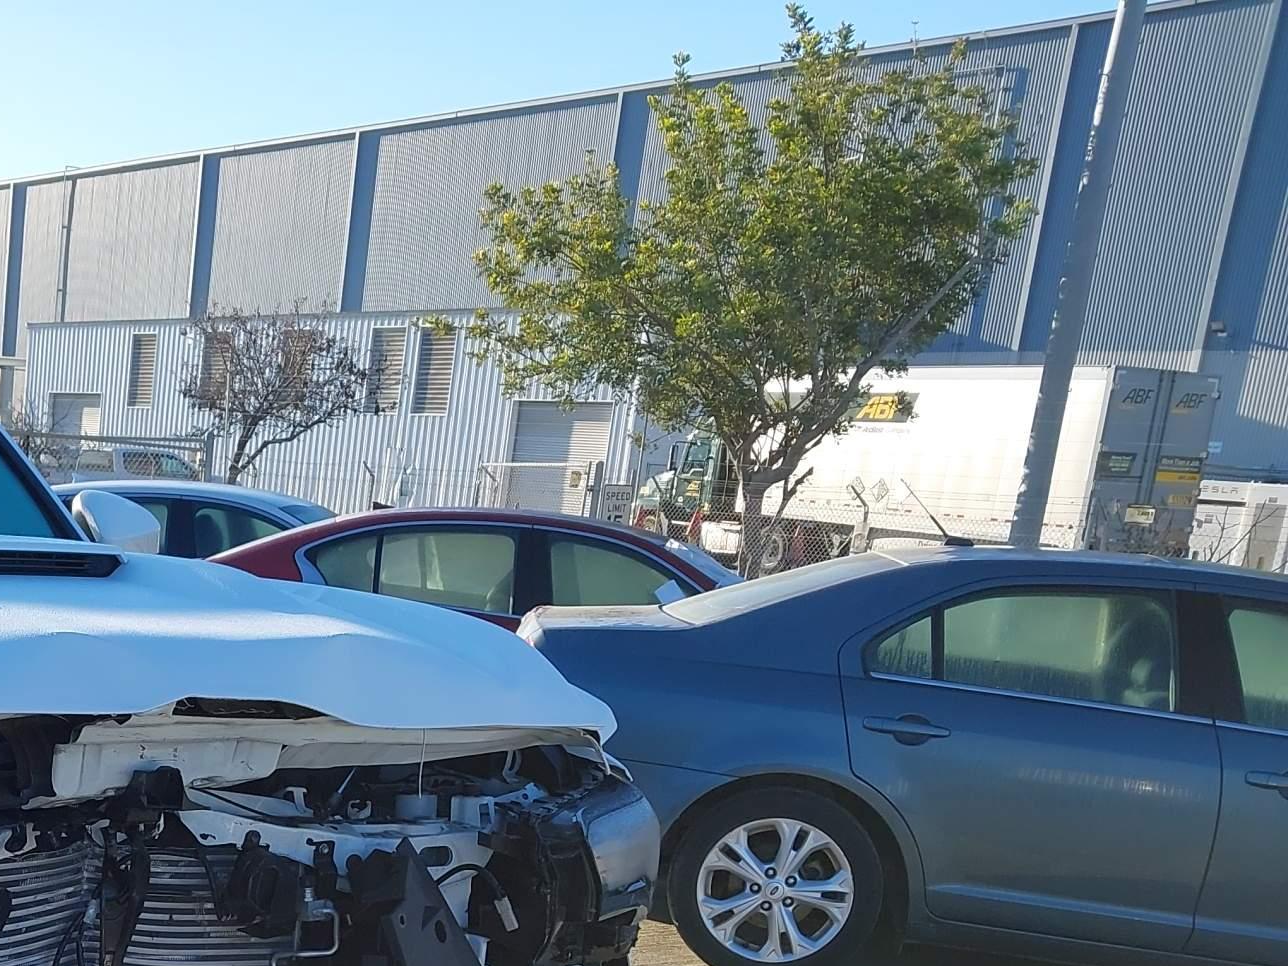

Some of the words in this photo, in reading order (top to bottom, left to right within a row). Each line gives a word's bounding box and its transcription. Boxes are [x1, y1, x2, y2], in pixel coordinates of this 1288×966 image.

[1122, 388, 1155, 404] ABF
[1175, 392, 1208, 408] ABF
[1201, 483, 1239, 495] ESLA
[606, 490, 631, 501] SPEED
[607, 503, 627, 513] LIMIT
